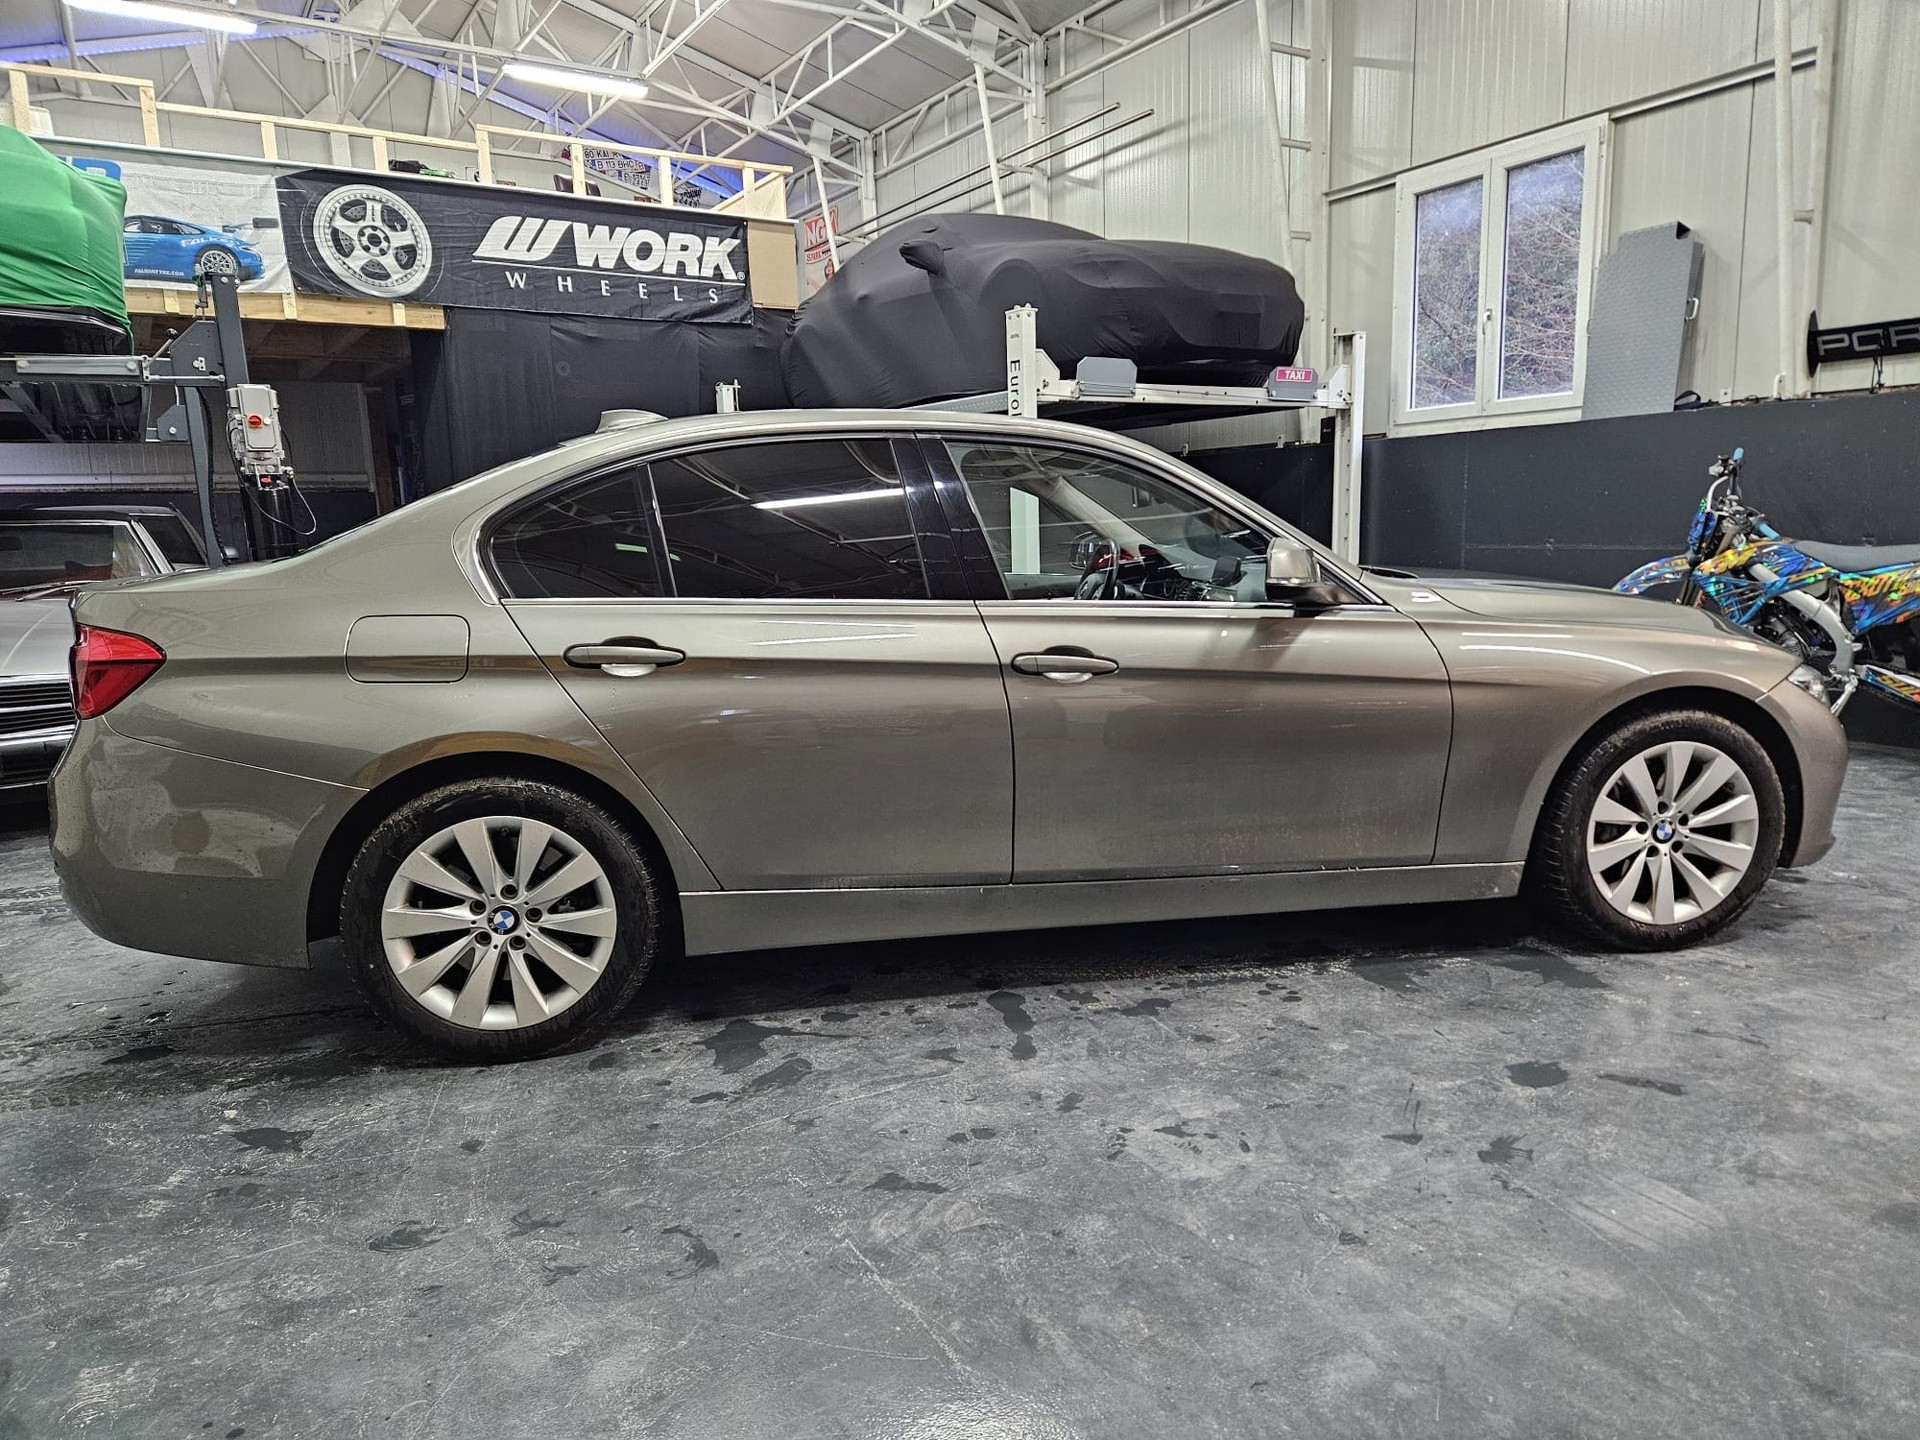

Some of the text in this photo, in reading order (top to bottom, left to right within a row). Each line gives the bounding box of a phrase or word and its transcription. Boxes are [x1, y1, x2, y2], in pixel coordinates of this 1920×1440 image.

[572, 222, 740, 280] WORK
[505, 270, 719, 303] WHEELS
[1284, 370, 1306, 380] TAXI
